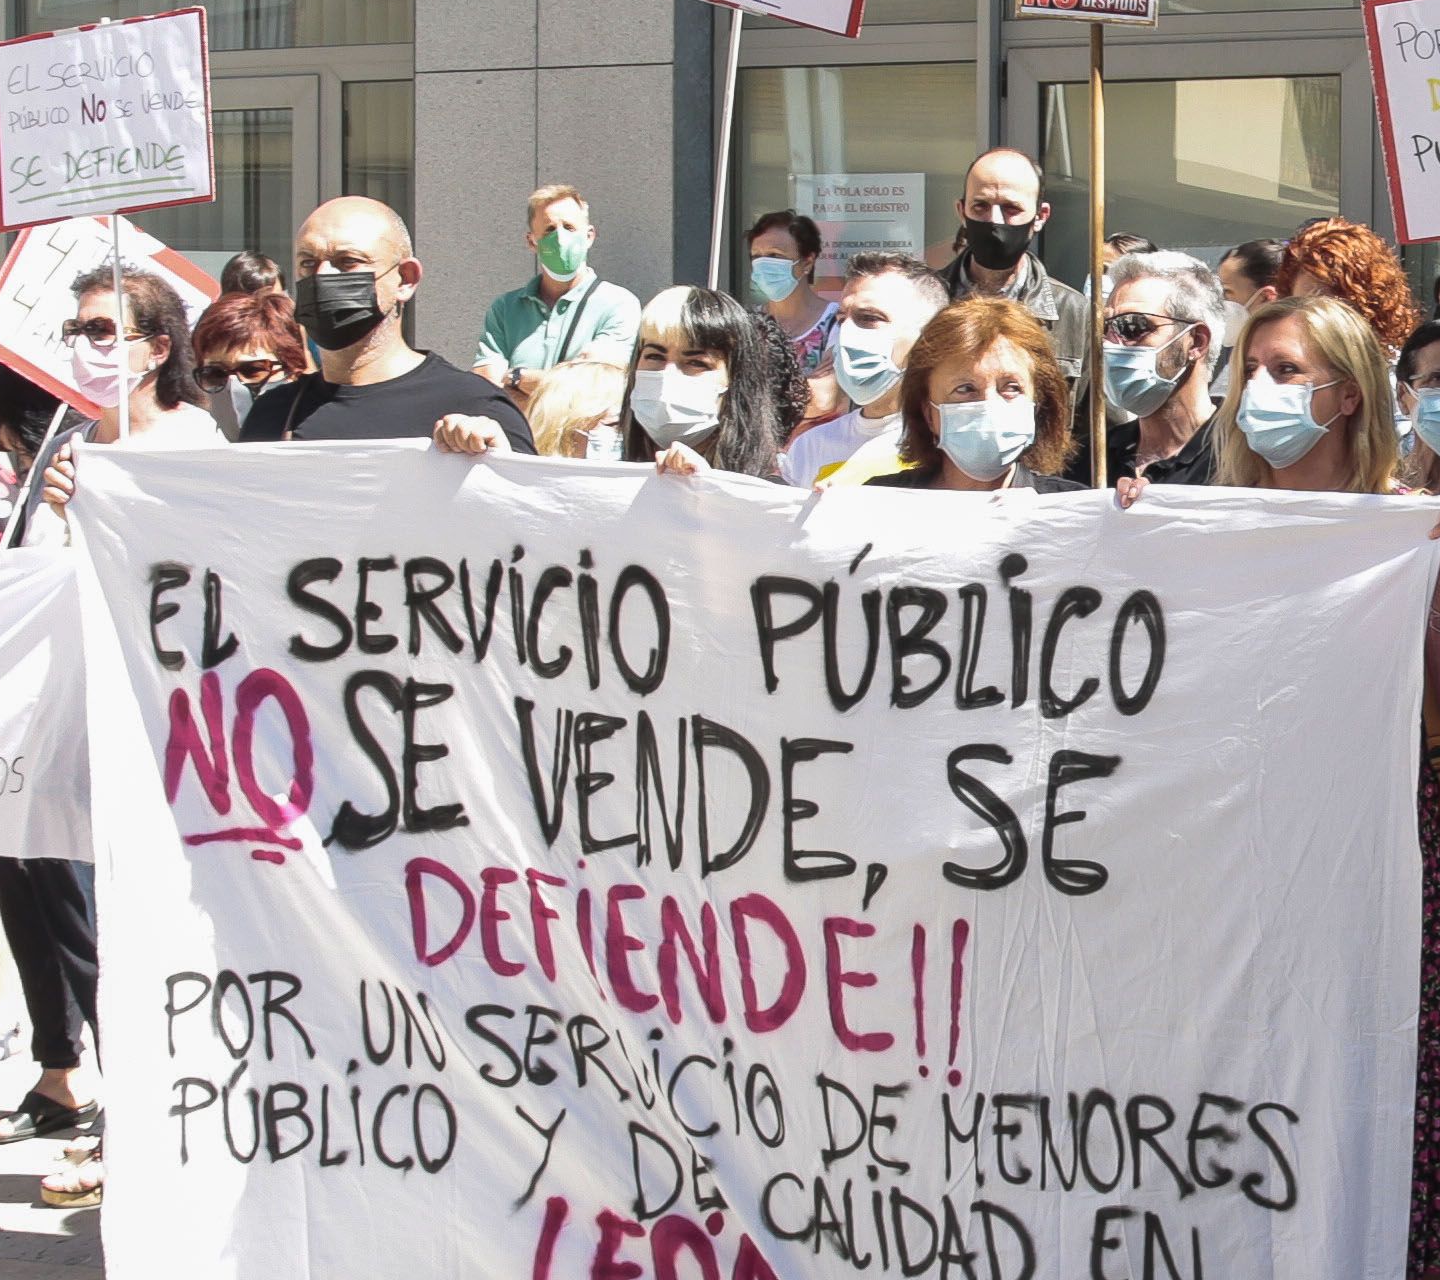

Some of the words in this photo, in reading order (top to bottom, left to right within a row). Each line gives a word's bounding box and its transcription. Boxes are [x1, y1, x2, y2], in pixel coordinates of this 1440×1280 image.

[7, 64, 40, 94] EL
[46, 51, 155, 91] SERVICIO
[8, 106, 69, 132] PÚBLICO
[81, 93, 106, 125] NO
[114, 99, 132, 119] SE
[141, 91, 202, 114] VENDE
[9, 156, 46, 193] SE
[63, 143, 185, 183] DEFIENDE
[892, 187, 905, 196] ES
[813, 204, 841, 213] PARA
[845, 203, 857, 212] EL
[860, 203, 910, 212] REGISTRO
[150, 562, 240, 671] EL
[287, 543, 671, 696] SERVICIO
[750, 543, 1166, 719] PÚBLICO
[164, 668, 313, 832] NO
[322, 669, 471, 851] SE
[515, 695, 888, 910] VENDE,
[942, 743, 1122, 896] SE
[164, 969, 315, 1062] POR
[360, 978, 447, 1072] UN
[464, 1003, 786, 1148] SERVICIO
[816, 1072, 910, 1173] DE
[942, 1087, 1299, 1212] MENORES
[169, 1061, 458, 1174] PÚBLICO
[512, 1107, 567, 1211] Y
[629, 1120, 729, 1221] DE
